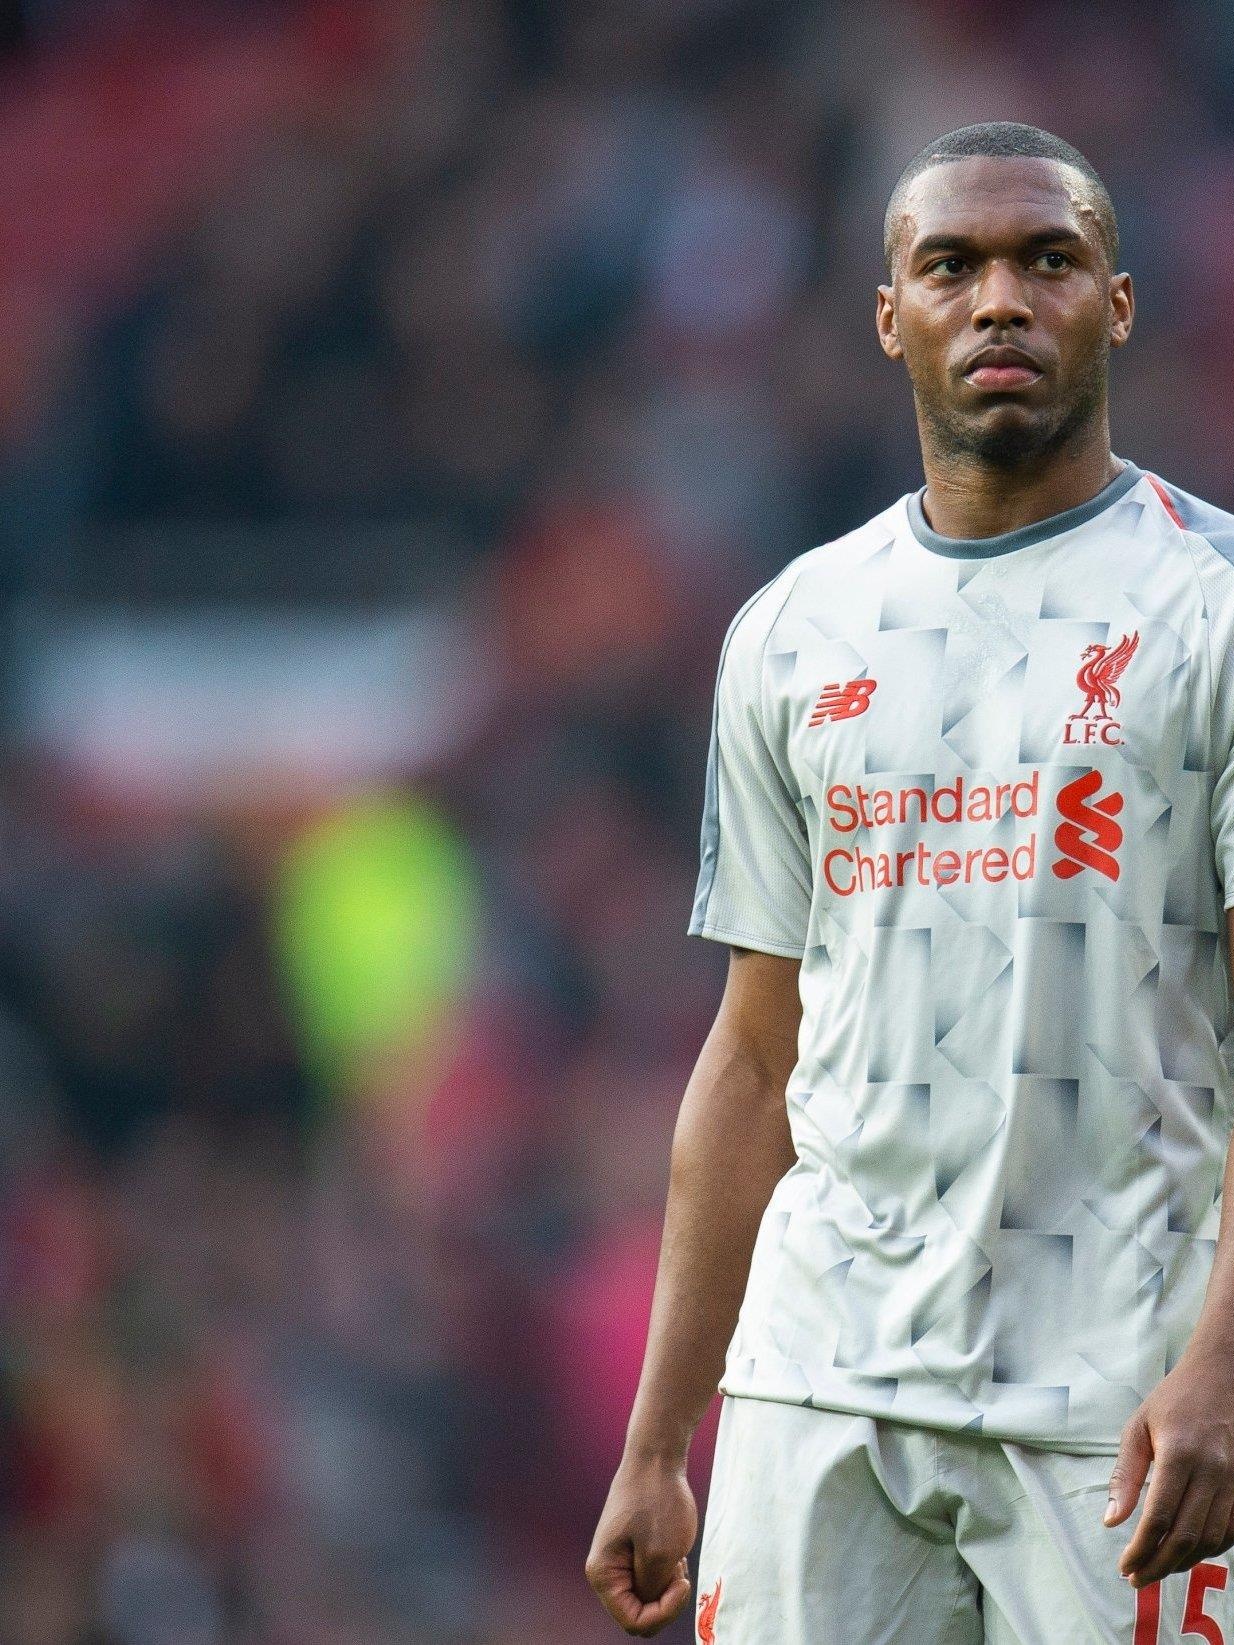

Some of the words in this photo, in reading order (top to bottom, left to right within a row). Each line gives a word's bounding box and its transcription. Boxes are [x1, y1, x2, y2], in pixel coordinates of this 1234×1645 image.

[1062, 722, 1126, 745] L.F.C.
[827, 770, 1040, 834] Standard
[823, 833, 1037, 897] Chartered
